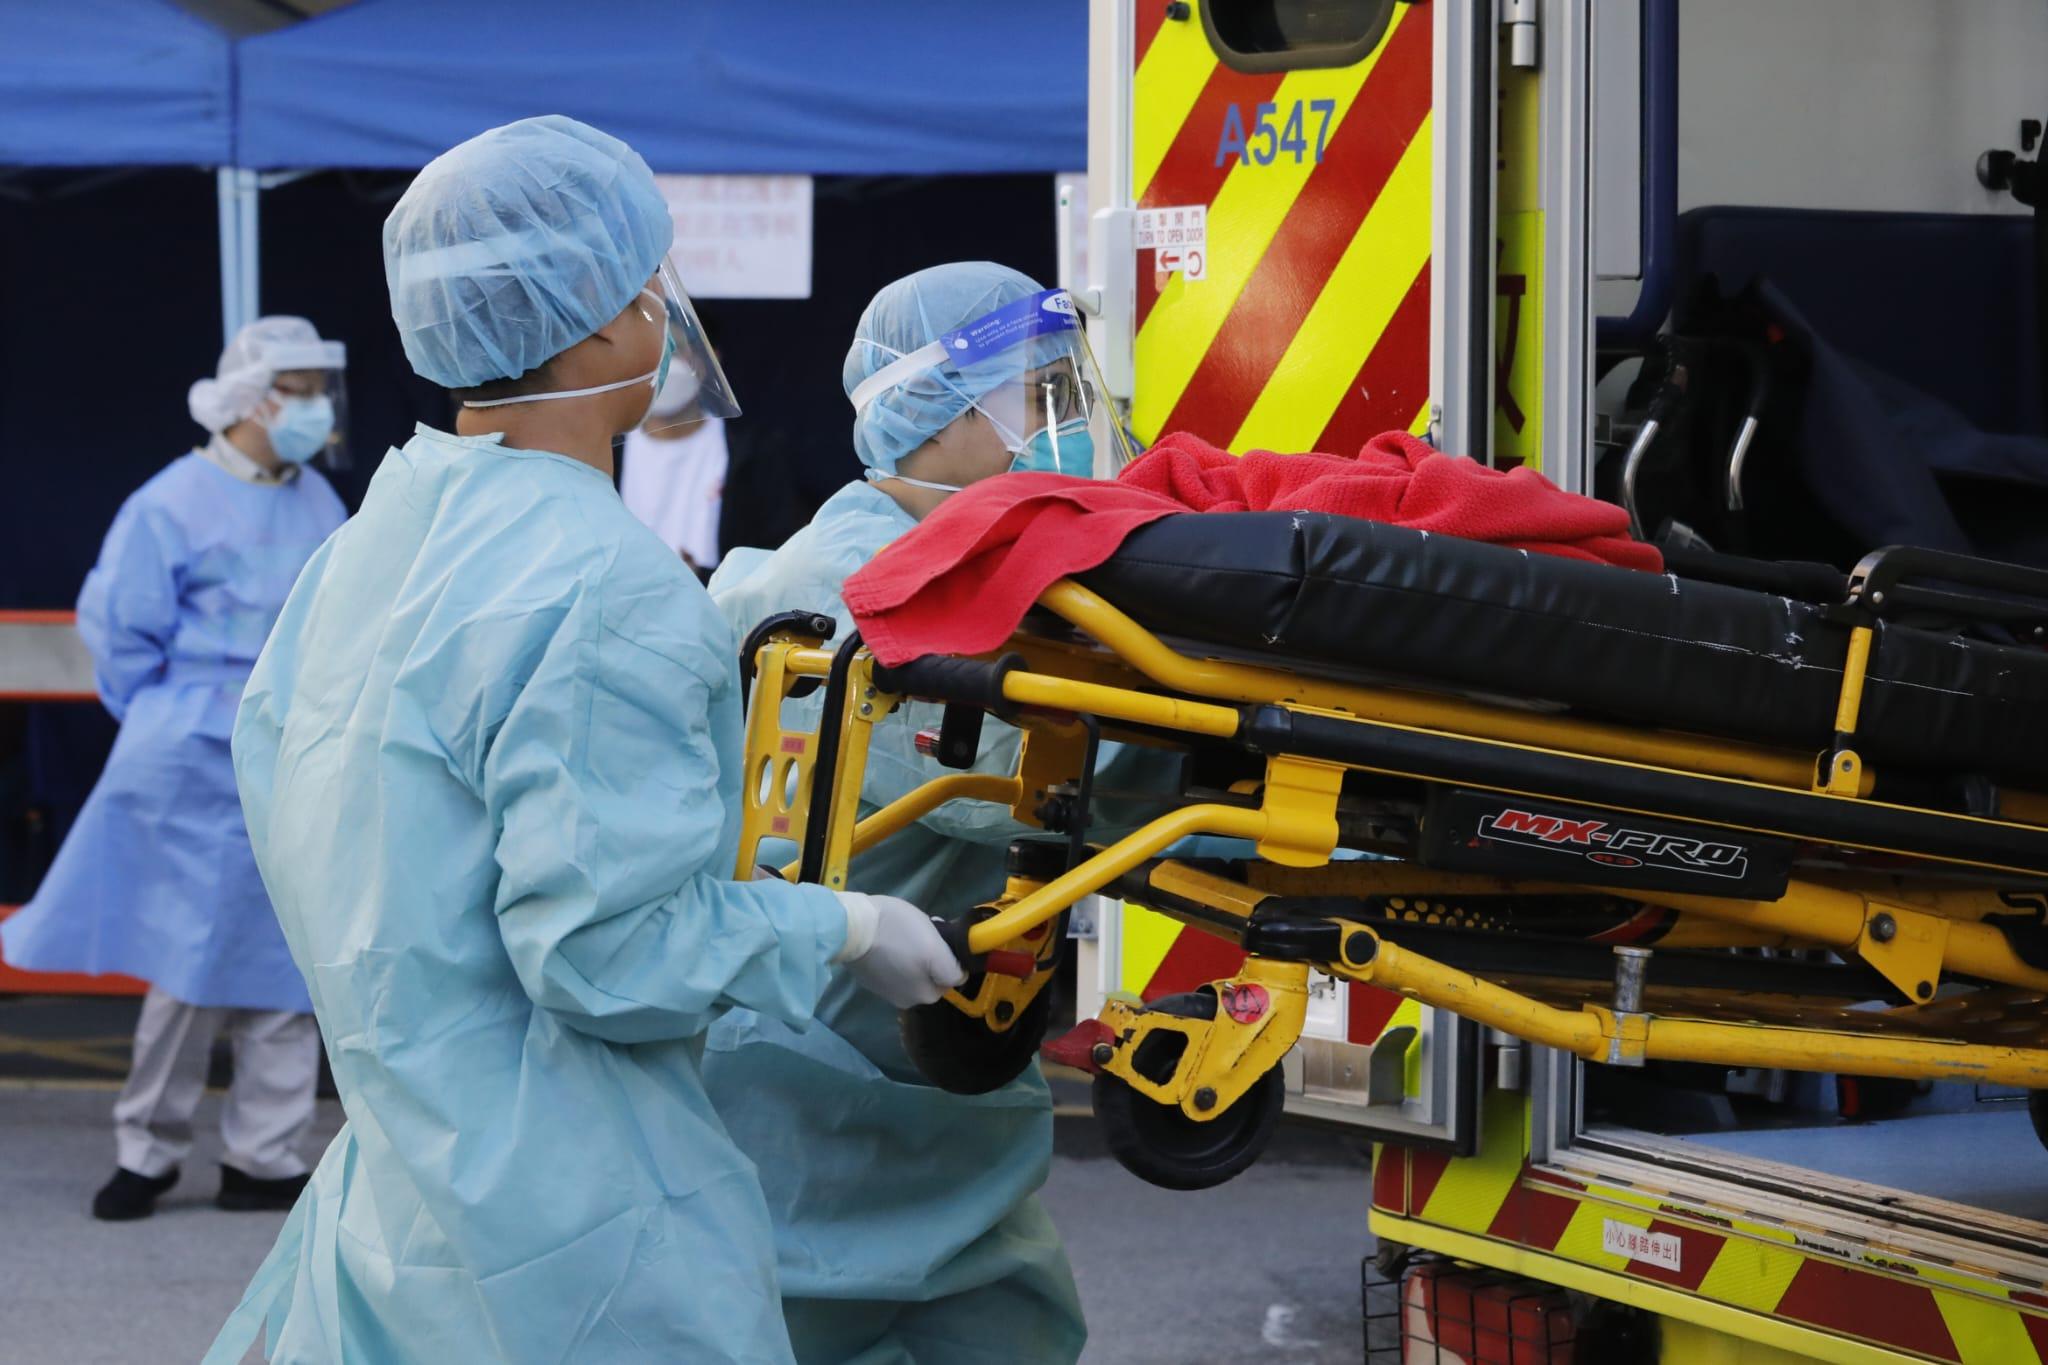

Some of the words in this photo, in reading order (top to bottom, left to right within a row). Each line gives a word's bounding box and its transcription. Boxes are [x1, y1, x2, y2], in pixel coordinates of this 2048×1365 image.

[1214, 98, 1336, 168] A547
[1156, 229, 1165, 244] TO
[1167, 227, 1184, 243] OPEN
[1186, 226, 1203, 242] DOOR
[1491, 808, 1745, 866] MX-PRO
